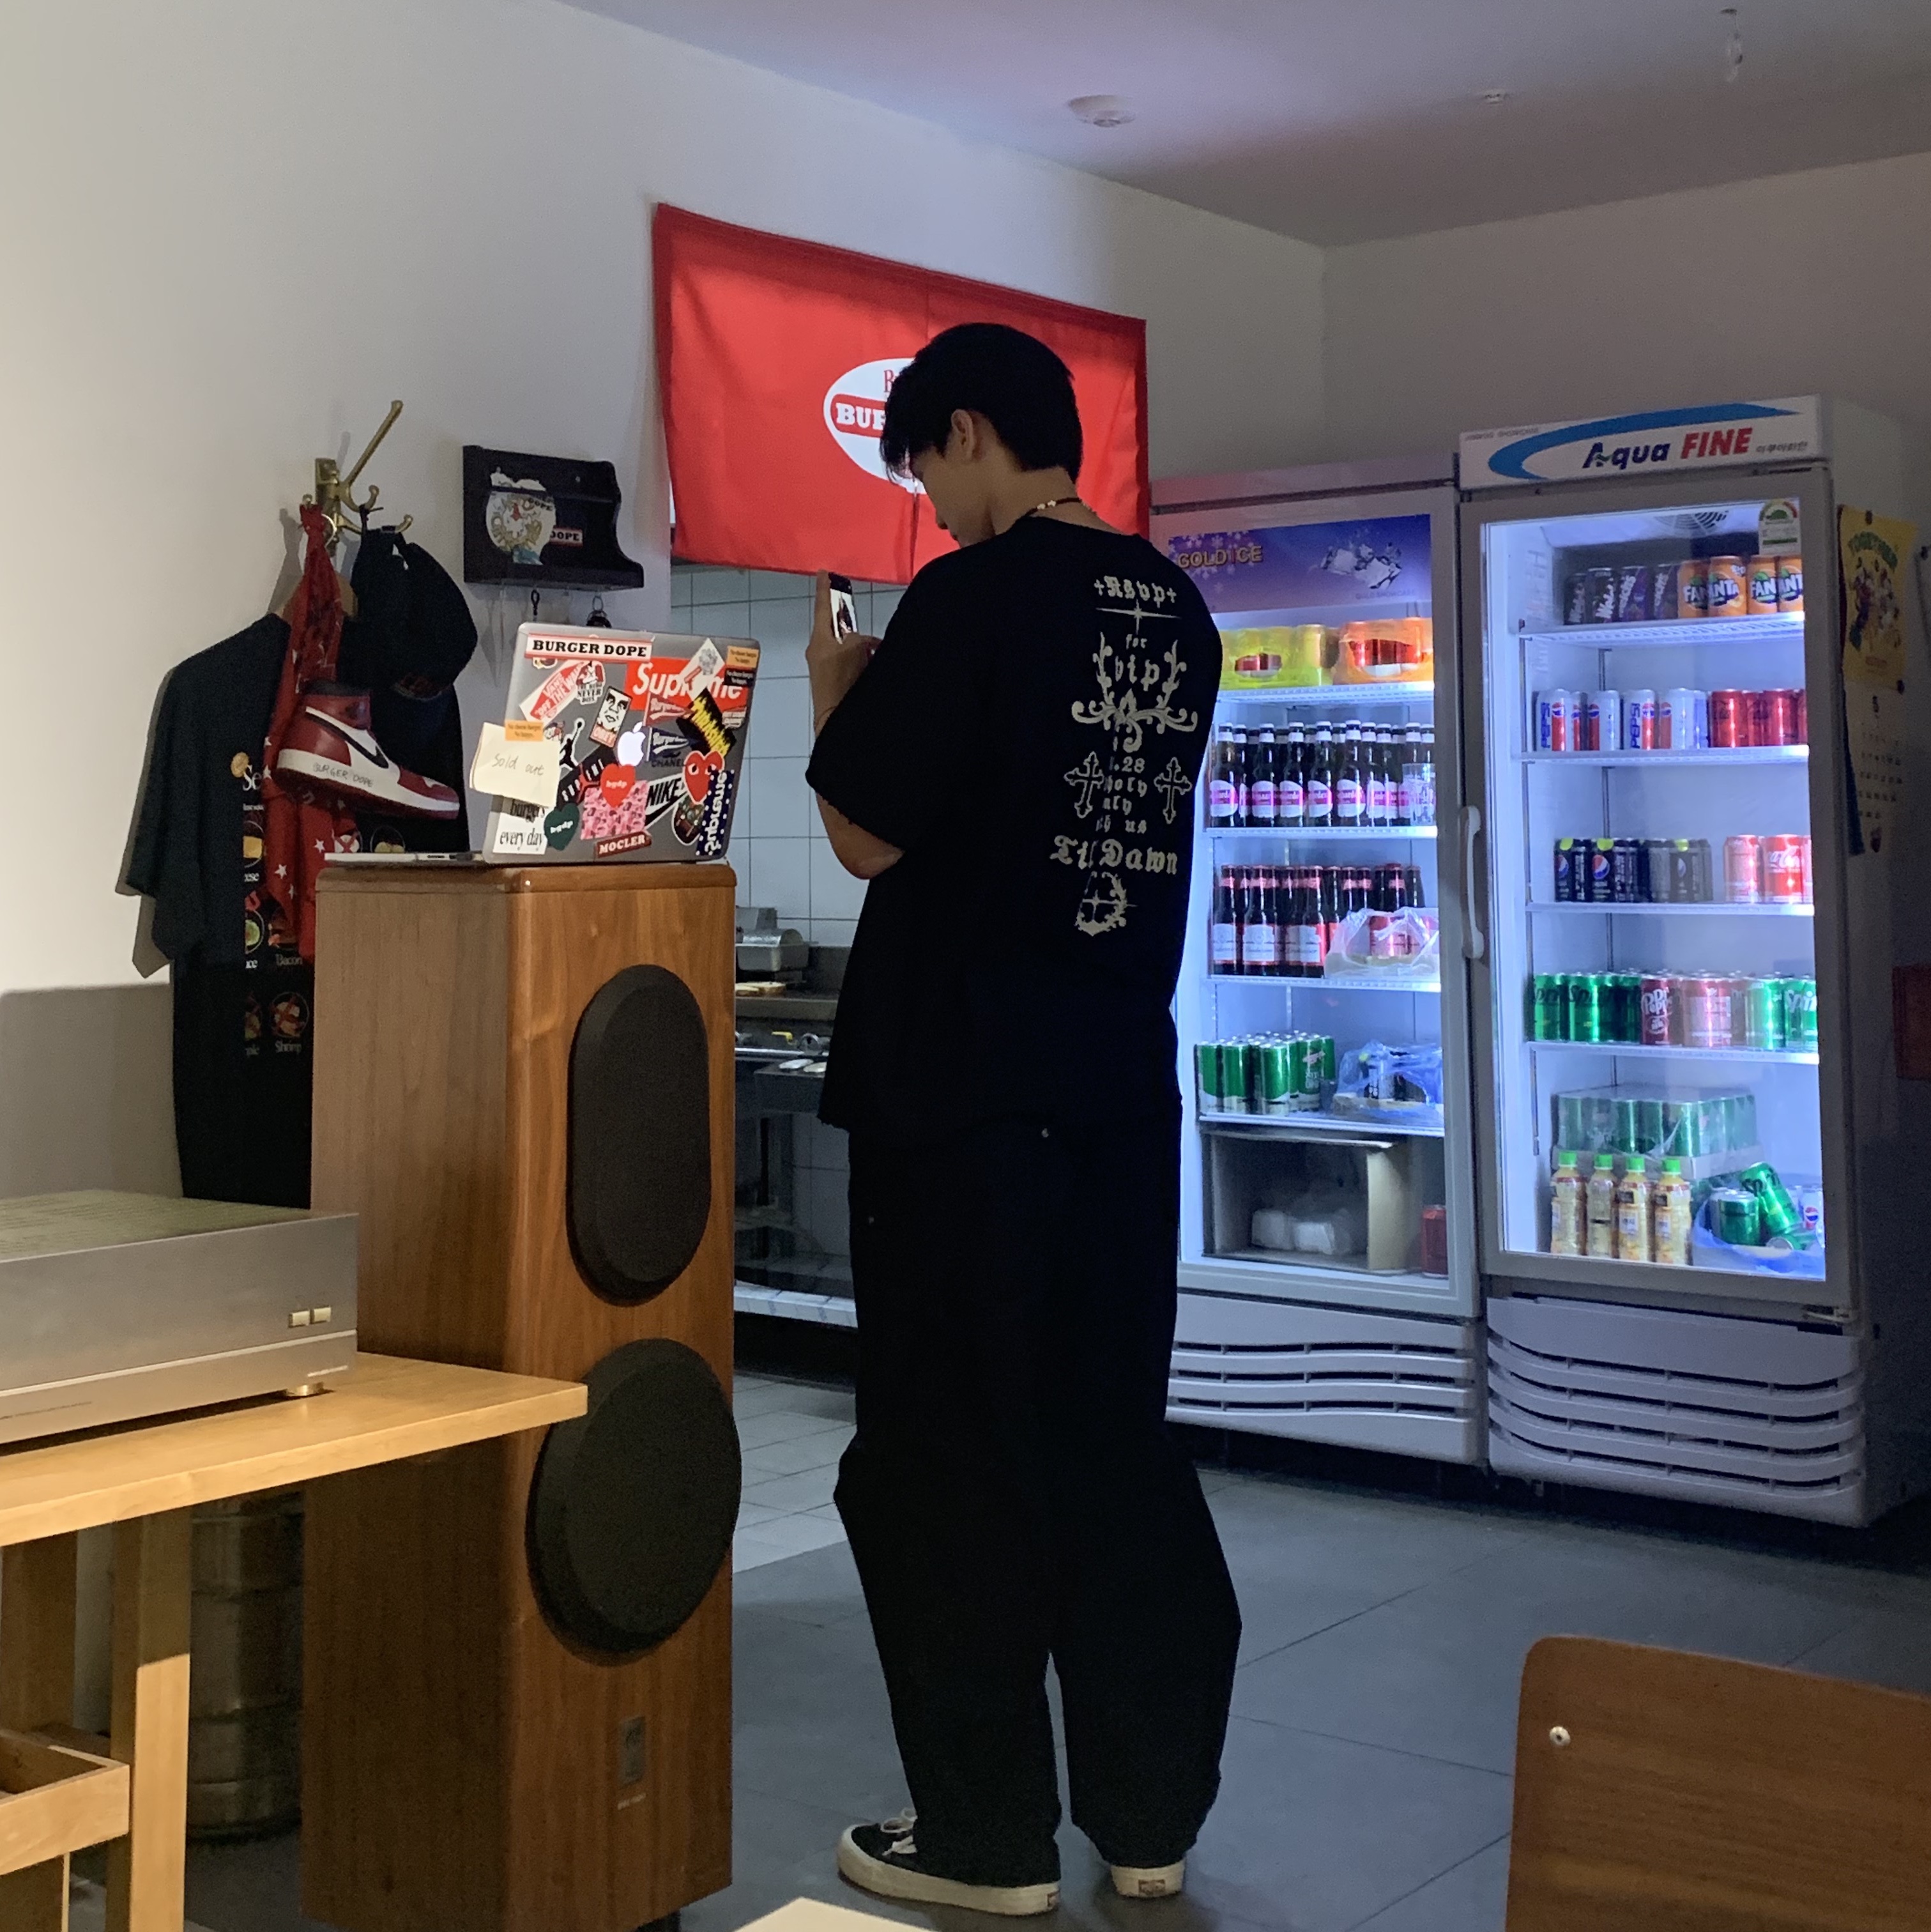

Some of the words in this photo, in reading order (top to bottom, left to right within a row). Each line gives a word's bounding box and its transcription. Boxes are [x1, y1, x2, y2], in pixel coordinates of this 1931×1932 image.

[836, 402, 886, 431] BUR
[1582, 441, 1671, 470] Aqua
[1681, 427, 1753, 459] FINE
[1178, 549, 1227, 569] GOLD
[1230, 546, 1263, 564] ICE
[1750, 577, 1777, 596] FAN
[533, 640, 600, 654] BURGER
[604, 644, 647, 657] DOPE
[1631, 703, 1640, 749] PEPSI
[312, 762, 349, 780] BURGER
[353, 774, 374, 788] DOPE
[492, 753, 518, 769] Sold
[525, 763, 544, 776] out
[243, 765, 262, 792] Se
[648, 778, 681, 806] NIKE
[500, 831, 524, 850] every
[527, 828, 543, 851] day
[599, 834, 645, 855] MOCLER
